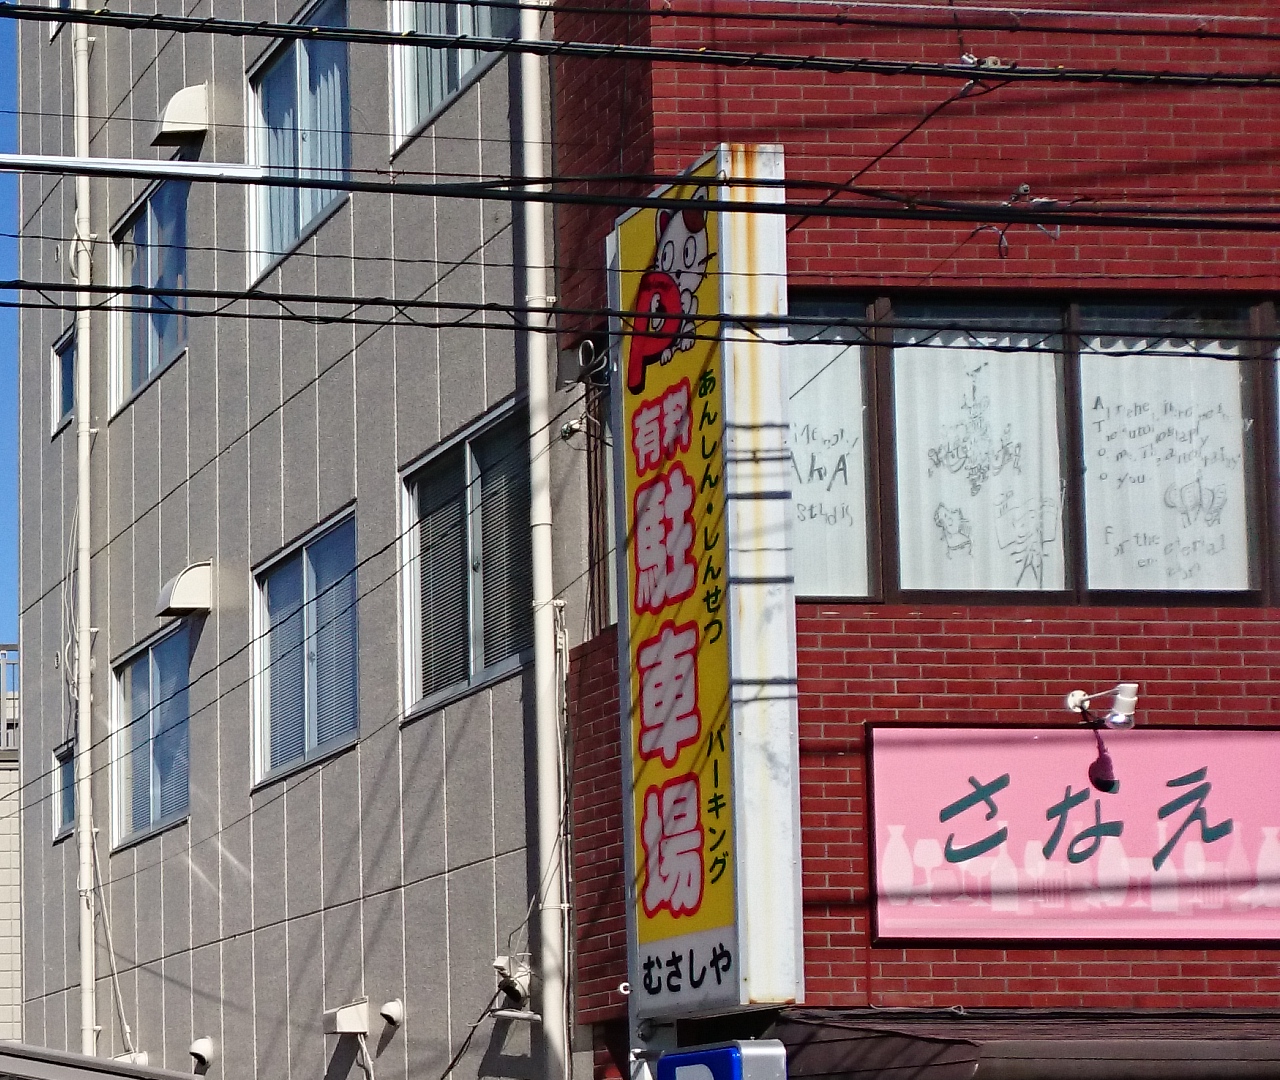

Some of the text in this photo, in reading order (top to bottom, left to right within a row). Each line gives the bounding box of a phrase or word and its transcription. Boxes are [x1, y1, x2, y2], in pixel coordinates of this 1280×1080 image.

[632, 377, 693, 477] 有料
[698, 369, 723, 644] あんしん・しんせつ
[633, 461, 704, 919] 駐車場
[706, 724, 729, 885] パーキング
[940, 765, 1234, 872] さなえ
[643, 942, 732, 995] むさしや
